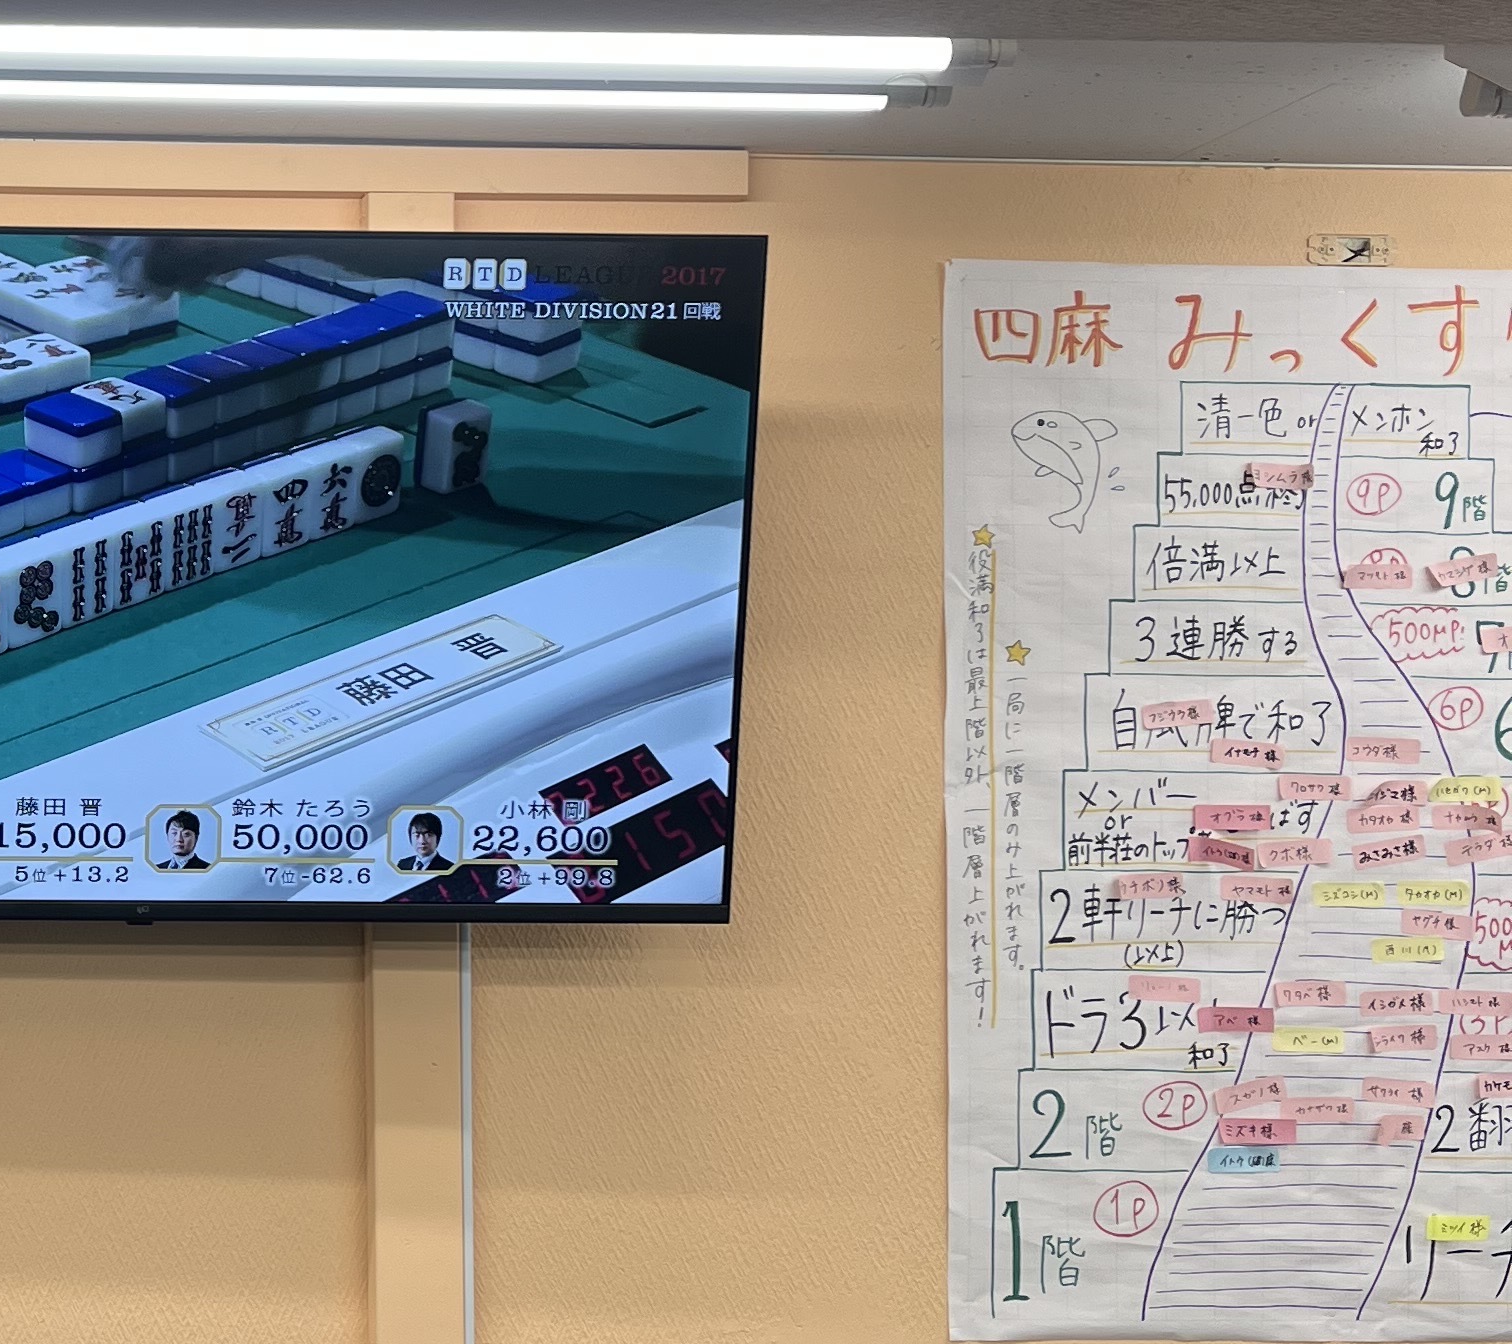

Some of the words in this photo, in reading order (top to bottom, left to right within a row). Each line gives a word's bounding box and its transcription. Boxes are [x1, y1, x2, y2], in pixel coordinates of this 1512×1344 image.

[661, 267, 726, 285] 2017
[445, 302, 525, 319] WHITE
[974, 290, 1123, 367] 四麻
[1197, 393, 1287, 439] 清一色
[1297, 415, 1318, 429] or
[1419, 432, 1459, 457] 和了
[1435, 471, 1487, 530] 9階
[1146, 535, 1285, 590] 倍満以上
[336, 662, 435, 706] 藤田
[15, 797, 66, 817] 藤田
[79, 798, 102, 816] 晋
[232, 798, 283, 818] 鈴木
[296, 799, 372, 818] たろう
[500, 801, 552, 820] 小林
[563, 801, 588, 820] 剛
[1078, 777, 1197, 818] メンバー
[1104, 815, 1132, 830] or
[233, 823, 369, 855] 50,000
[472, 825, 609, 856] 22,600
[1046, 985, 1208, 1059] ドラ3以
[1188, 1041, 1230, 1070] 和了
[1029, 1089, 1123, 1159] 2階
[1002, 1200, 1086, 1302] 1階
